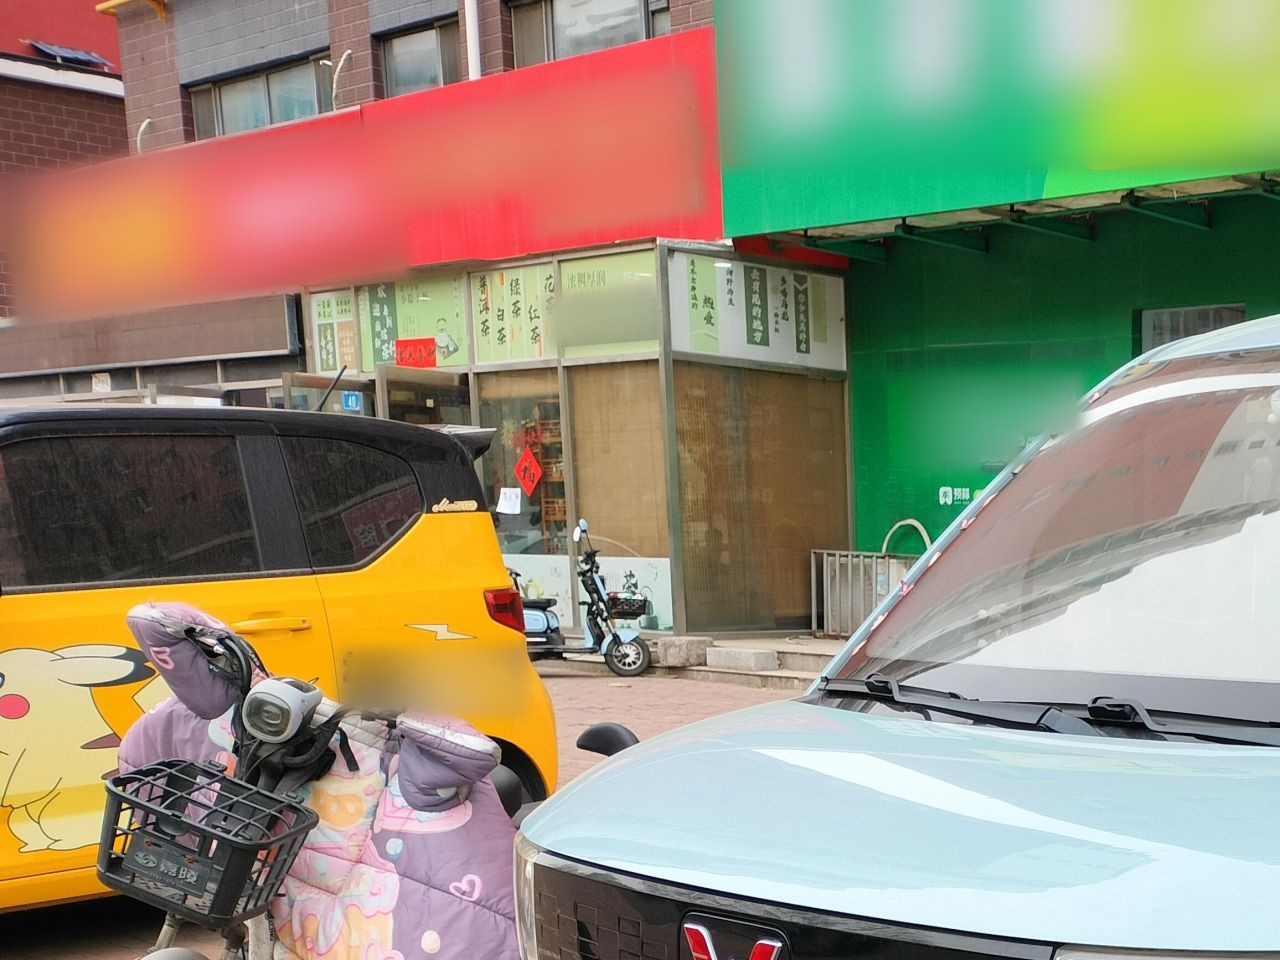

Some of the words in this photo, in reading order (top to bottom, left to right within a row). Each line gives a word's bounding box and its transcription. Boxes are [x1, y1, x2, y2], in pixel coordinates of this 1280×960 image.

[509, 278, 521, 319] 绿茶
[567, 270, 606, 290] 浓稠厚润
[479, 276, 490, 337] 普洱茶
[528, 304, 541, 345] 红茶
[496, 308, 507, 346] 白茶
[521, 458, 536, 486] 福
